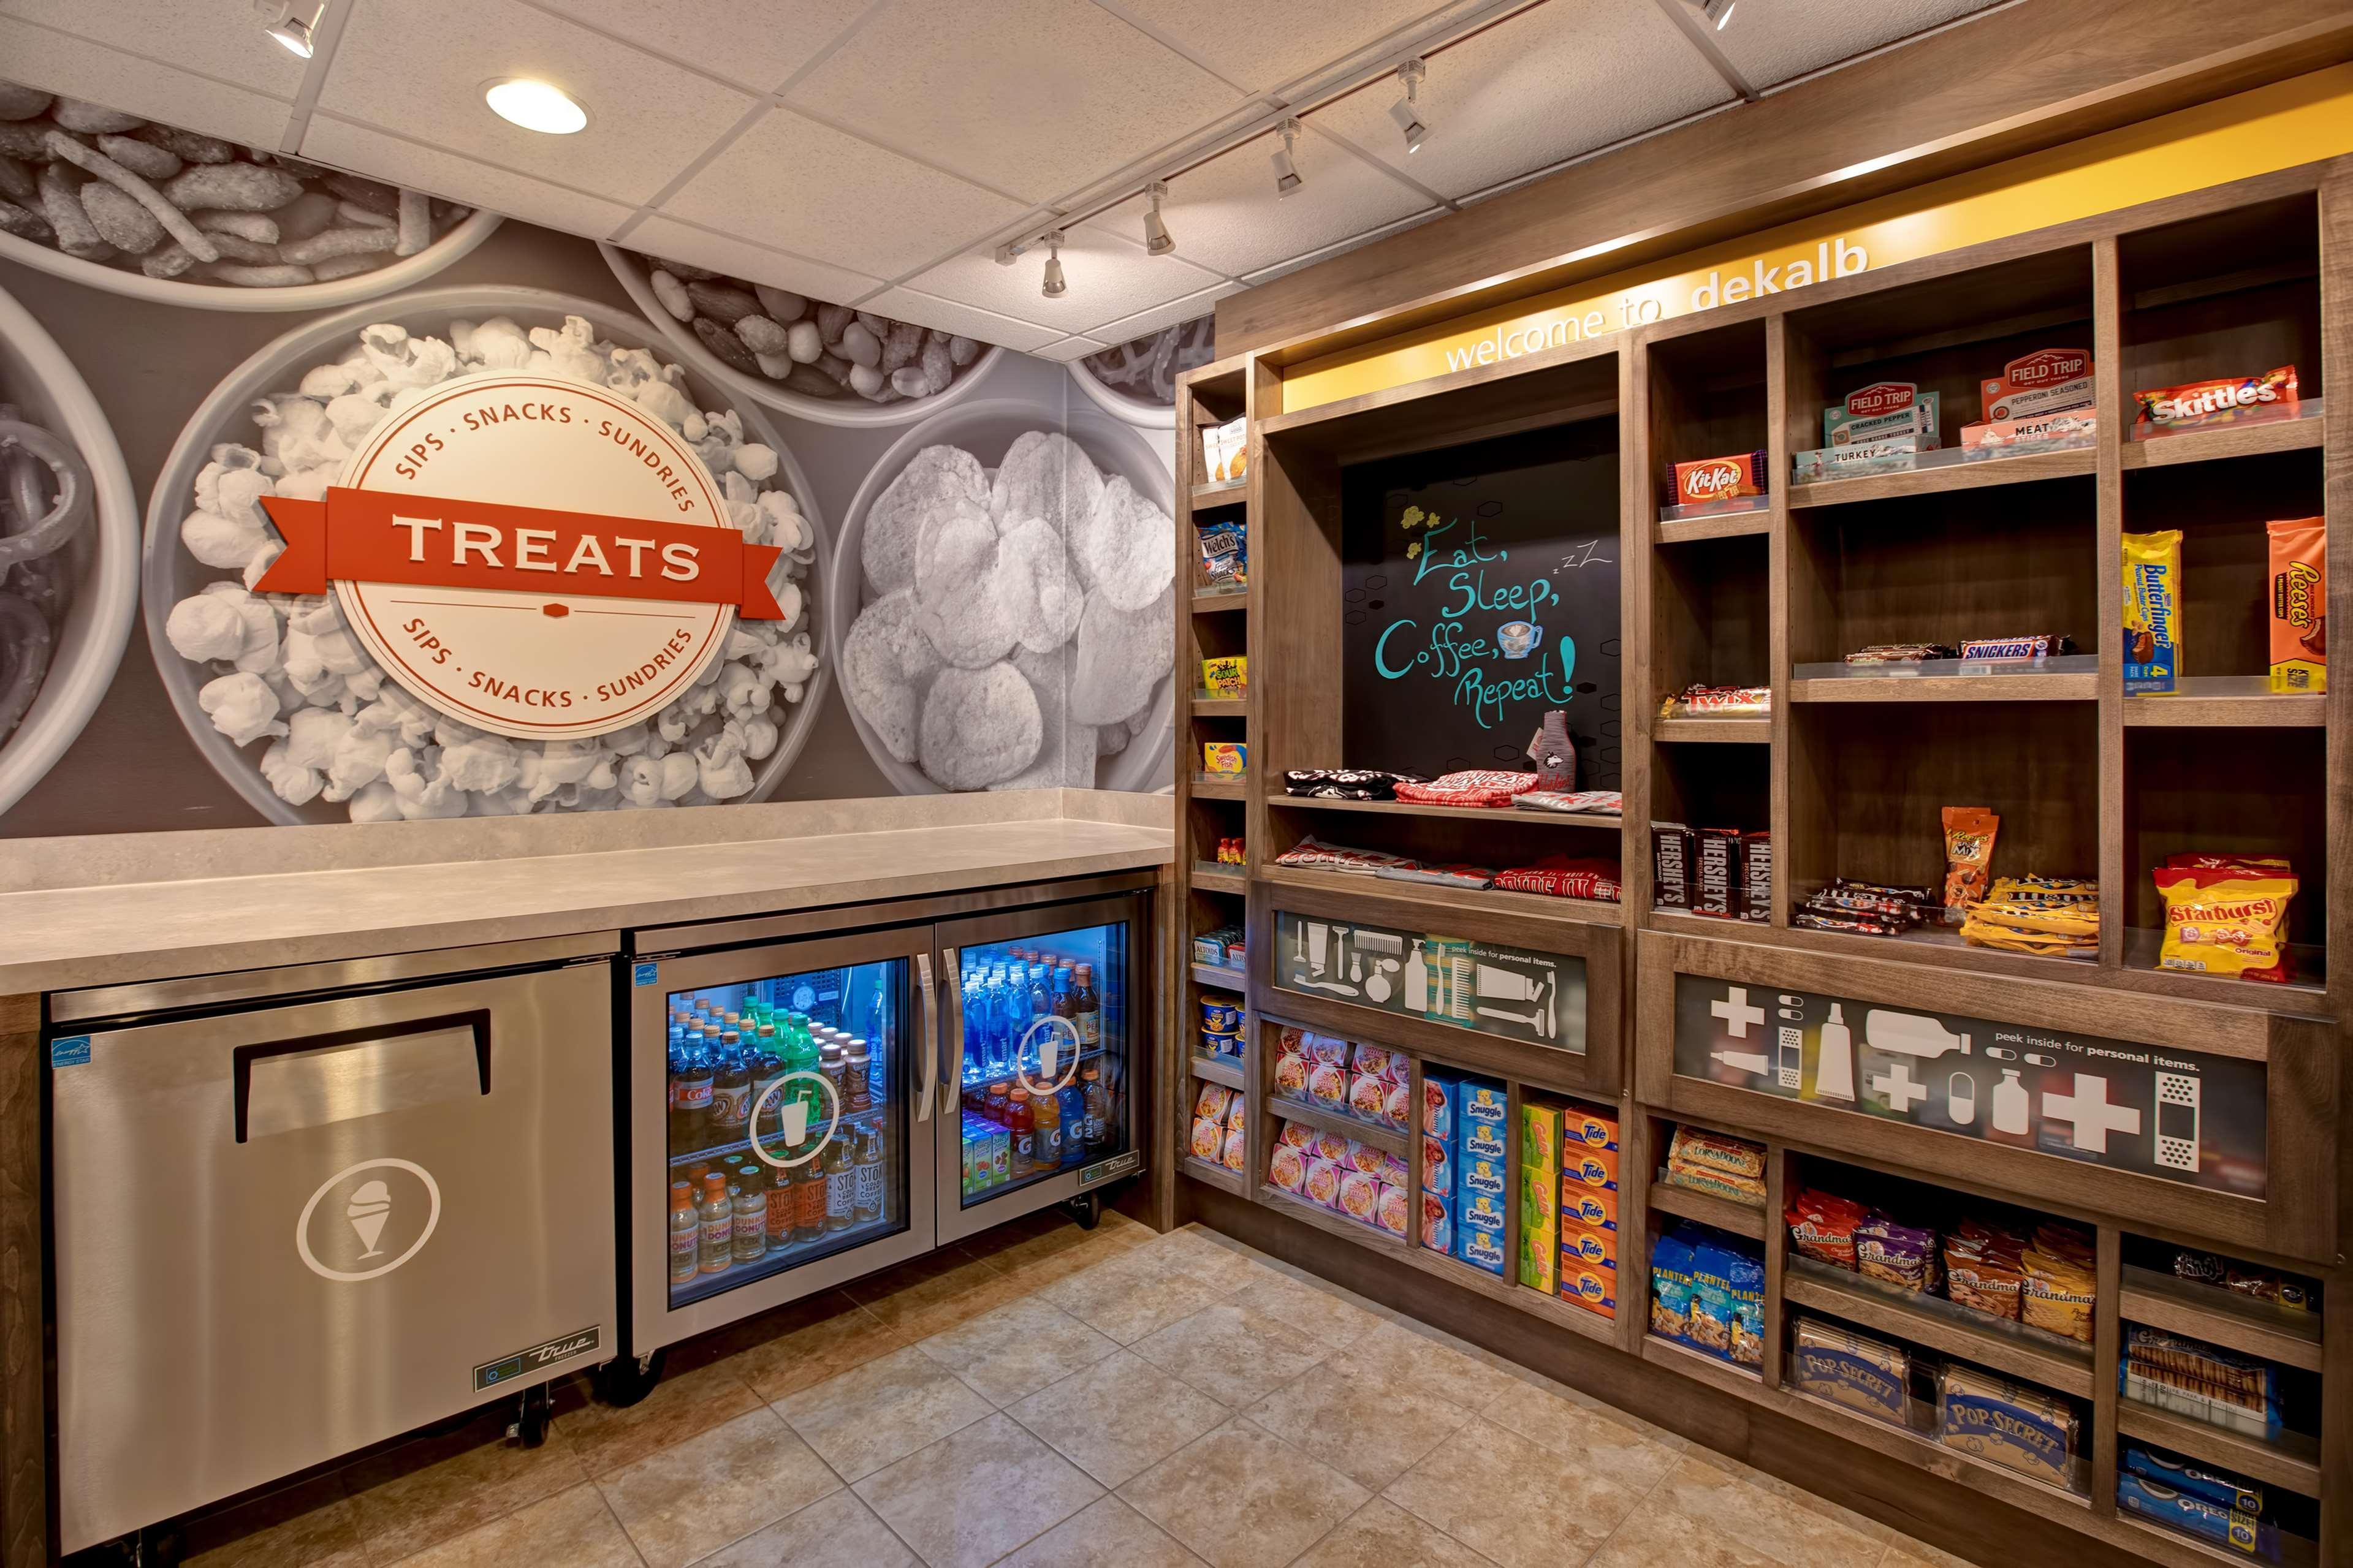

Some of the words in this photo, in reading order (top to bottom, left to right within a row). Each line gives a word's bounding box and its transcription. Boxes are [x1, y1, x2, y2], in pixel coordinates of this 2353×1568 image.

[1445, 309, 1606, 373] welcome
[1619, 297, 1664, 327] to
[1690, 238, 1869, 312] dekalb
[2012, 364, 2049, 382] FIELD
[2051, 358, 2083, 374] TRIP
[1851, 396, 1883, 410] FIELD
[1884, 391, 1911, 405] TRIP
[2012, 391, 2049, 405] PEPPERONI
[2050, 382, 2088, 396] SEASONED
[2152, 384, 2278, 424] Skittles
[1851, 419, 1882, 430] CRACKED
[1884, 412, 1910, 423] PEPPER
[2015, 423, 2050, 436] MEAT
[394, 431, 445, 481] SIPS
[463, 403, 572, 431] SNACKS
[597, 420, 695, 513] SUNDRIES
[1834, 449, 1876, 462] TURKEY
[392, 513, 702, 581] TREATS
[1203, 534, 1236, 555] Welch's
[1413, 518, 1508, 586] Eat,
[1441, 572, 1560, 622] Sleep,
[2289, 560, 2322, 629] Reese's
[2144, 563, 2172, 649] Butterfinger
[1374, 619, 1500, 679] Coffee,
[1964, 643, 2032, 659] SNICKERS
[403, 618, 453, 665] SIPS
[468, 671, 572, 708] SNACKS
[596, 627, 692, 702] SUNDRIES
[1216, 667, 1239, 679] SOUR
[1217, 676, 1241, 687] PATCH
[1454, 635, 1576, 729] Repeat!
[1215, 754, 1237, 765] Swedish
[1221, 760, 1234, 770] Fish
[1659, 835, 1685, 904] HERSHEY'S
[1703, 838, 1728, 914] HERSHEY'S
[1749, 843, 1771, 920] HERSHEY'S
[2169, 899, 2275, 923] Starburst
[1196, 945, 1218, 956] ALTOIDS
[1232, 953, 1246, 962] ALTO
[1451, 945, 1467, 954] peek
[1469, 948, 1488, 957] inside
[1499, 953, 1532, 964] personal
[1533, 957, 1557, 968] items.
[2235, 948, 2271, 957] Original
[1995, 1031, 2024, 1043] peek
[2026, 1036, 2062, 1050] inside
[2064, 1041, 2085, 1053] for
[2086, 1047, 2150, 1064] personal
[2153, 1055, 2201, 1072] items.
[686, 1086, 713, 1100] Coke
[1470, 1103, 1502, 1118] Snuggle
[1584, 1124, 1606, 1139] Tide
[1469, 1139, 1502, 1154] Snuggle
[1582, 1164, 1605, 1178] Tide
[837, 1172, 854, 1191] STŌ
[1469, 1175, 1501, 1190] Snuggle
[808, 1182, 825, 1201] STŌ
[736, 1214, 766, 1225] DUNKI
[1468, 1210, 1500, 1226] Snuggle
[1581, 1202, 1603, 1218] Tide
[736, 1221, 766, 1233] DONUT
[1790, 1225, 1853, 1244] Grandma's
[1468, 1245, 1501, 1261] Snuggle
[1579, 1240, 1603, 1256] Tide
[1857, 1243, 1922, 1266] Grandma's
[1652, 1267, 1693, 1287] PLANTERS
[1693, 1271, 1731, 1292] PLANTE
[1948, 1269, 2020, 1292] Grandma'
[1579, 1279, 1602, 1295] Tide
[2022, 1279, 2096, 1305] Grandma's
[1731, 1289, 1765, 1306] PLANTE
[554, 1350, 577, 1362] FREEZER
[1804, 1354, 1837, 1374] POP
[1839, 1360, 1896, 1398] SECRET
[1950, 1403, 1990, 1426] POP
[1991, 1411, 2059, 1454] SECRET
[2177, 1499, 2229, 1520] OREO
[2241, 1498, 2256, 1509] 10
[2236, 1528, 2249, 1540] 10
